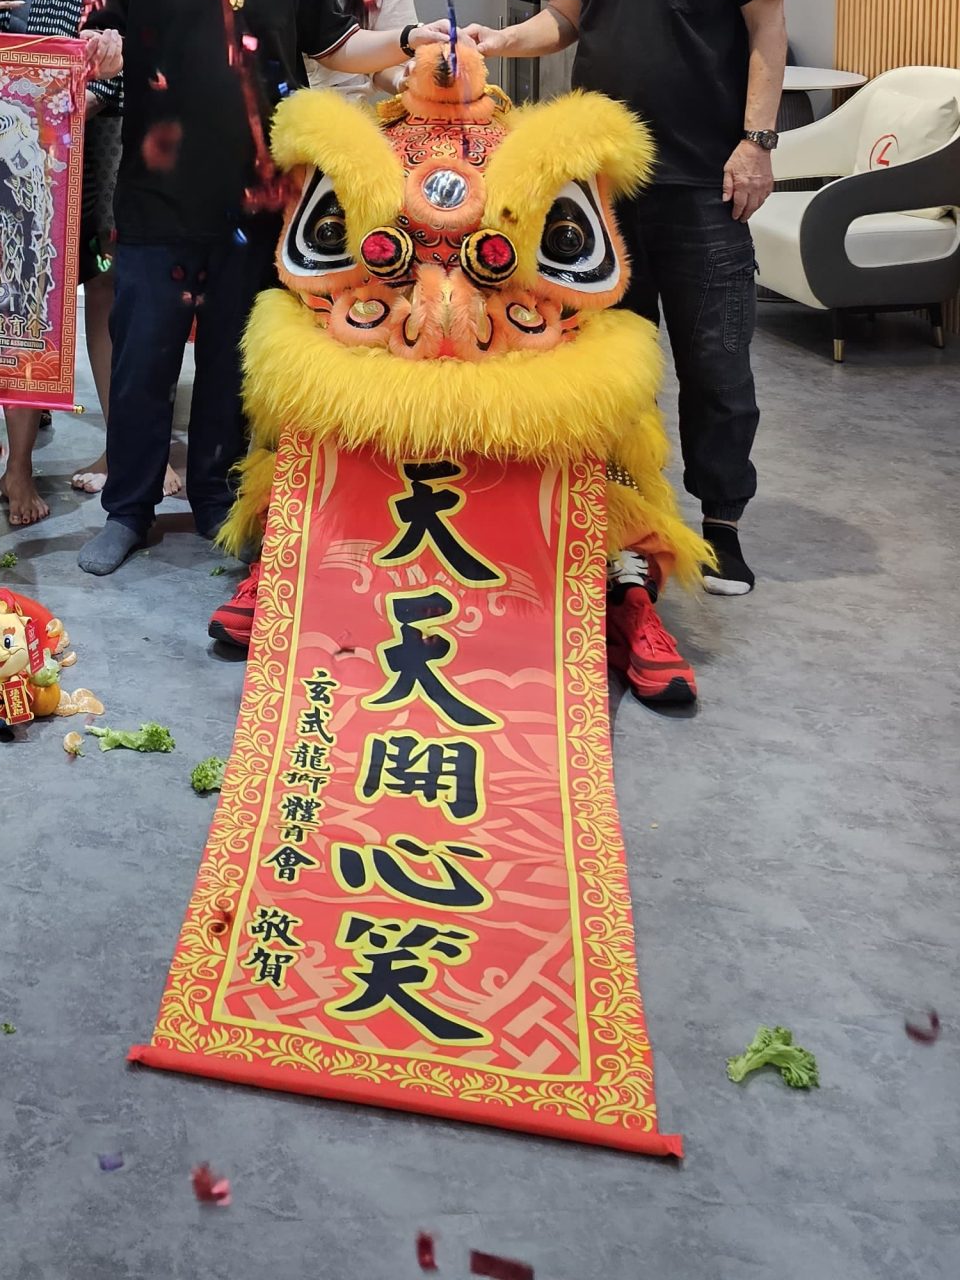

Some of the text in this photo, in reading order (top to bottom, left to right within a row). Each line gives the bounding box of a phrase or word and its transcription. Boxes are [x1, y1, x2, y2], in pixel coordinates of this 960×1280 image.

[333, 461, 501, 1042] 天天開心笑
[245, 906, 303, 988] 敬賀
